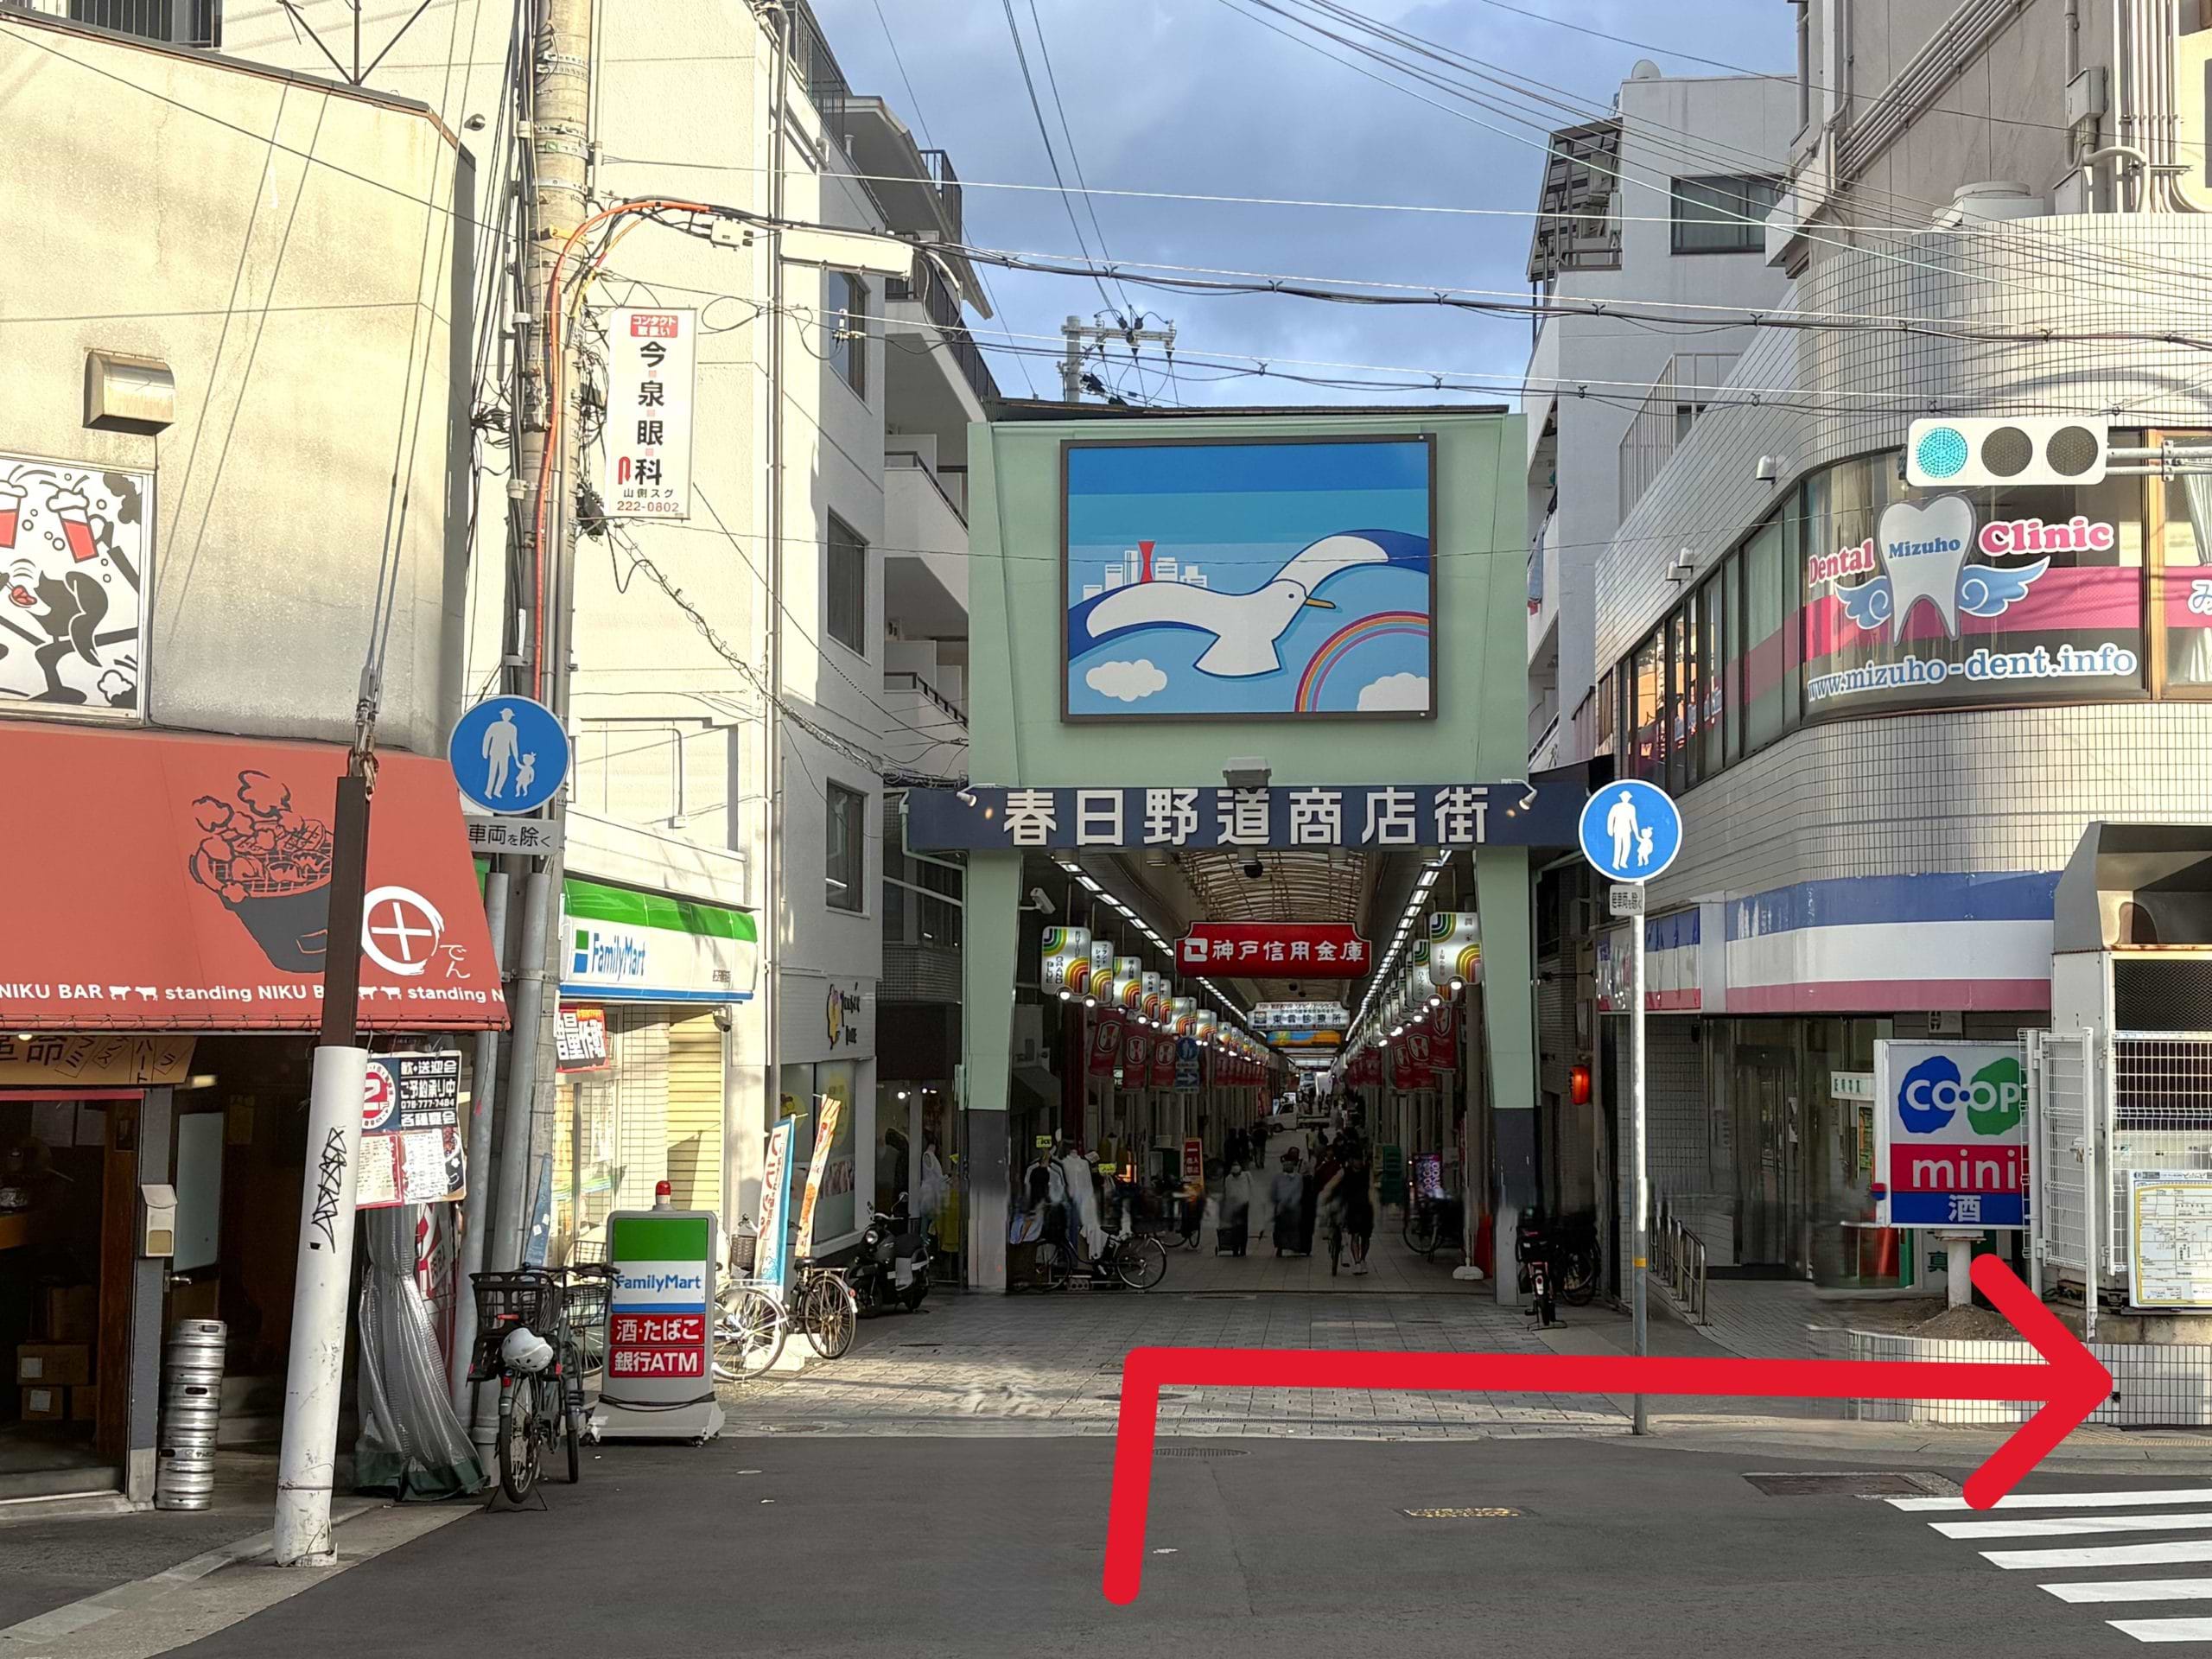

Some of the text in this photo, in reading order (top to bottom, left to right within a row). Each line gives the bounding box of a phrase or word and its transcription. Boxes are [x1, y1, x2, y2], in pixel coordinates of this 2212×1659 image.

[632, 316, 677, 325] コンタクト
[634, 340, 667, 486] 今泉眼科
[623, 488, 674, 499] 山側スグ
[617, 500, 679, 512] 222-0802
[1809, 518, 2113, 582] Dental Clinic
[1889, 537, 1961, 559] Mizuho
[1808, 644, 2136, 701] www.mizuho-dent.info
[1004, 787, 1488, 846] 春日野道商店街
[468, 823, 551, 848] 車両を除く
[592, 932, 645, 982] FamilyMart
[1212, 940, 1365, 963] 神戸信用金庫
[0, 983, 50, 999] NIKU
[58, 983, 104, 1000] BAR
[165, 985, 252, 1002] standing
[258, 985, 307, 1000] NIKU
[408, 987, 486, 1004] standing
[1912, 1148, 2017, 1190] mini
[1948, 1193, 1981, 1223] 酒
[616, 1274, 702, 1293] FamilyMart
[616, 1318, 700, 1343] 酒・たばこ
[614, 1351, 698, 1373] 銀行ATM
